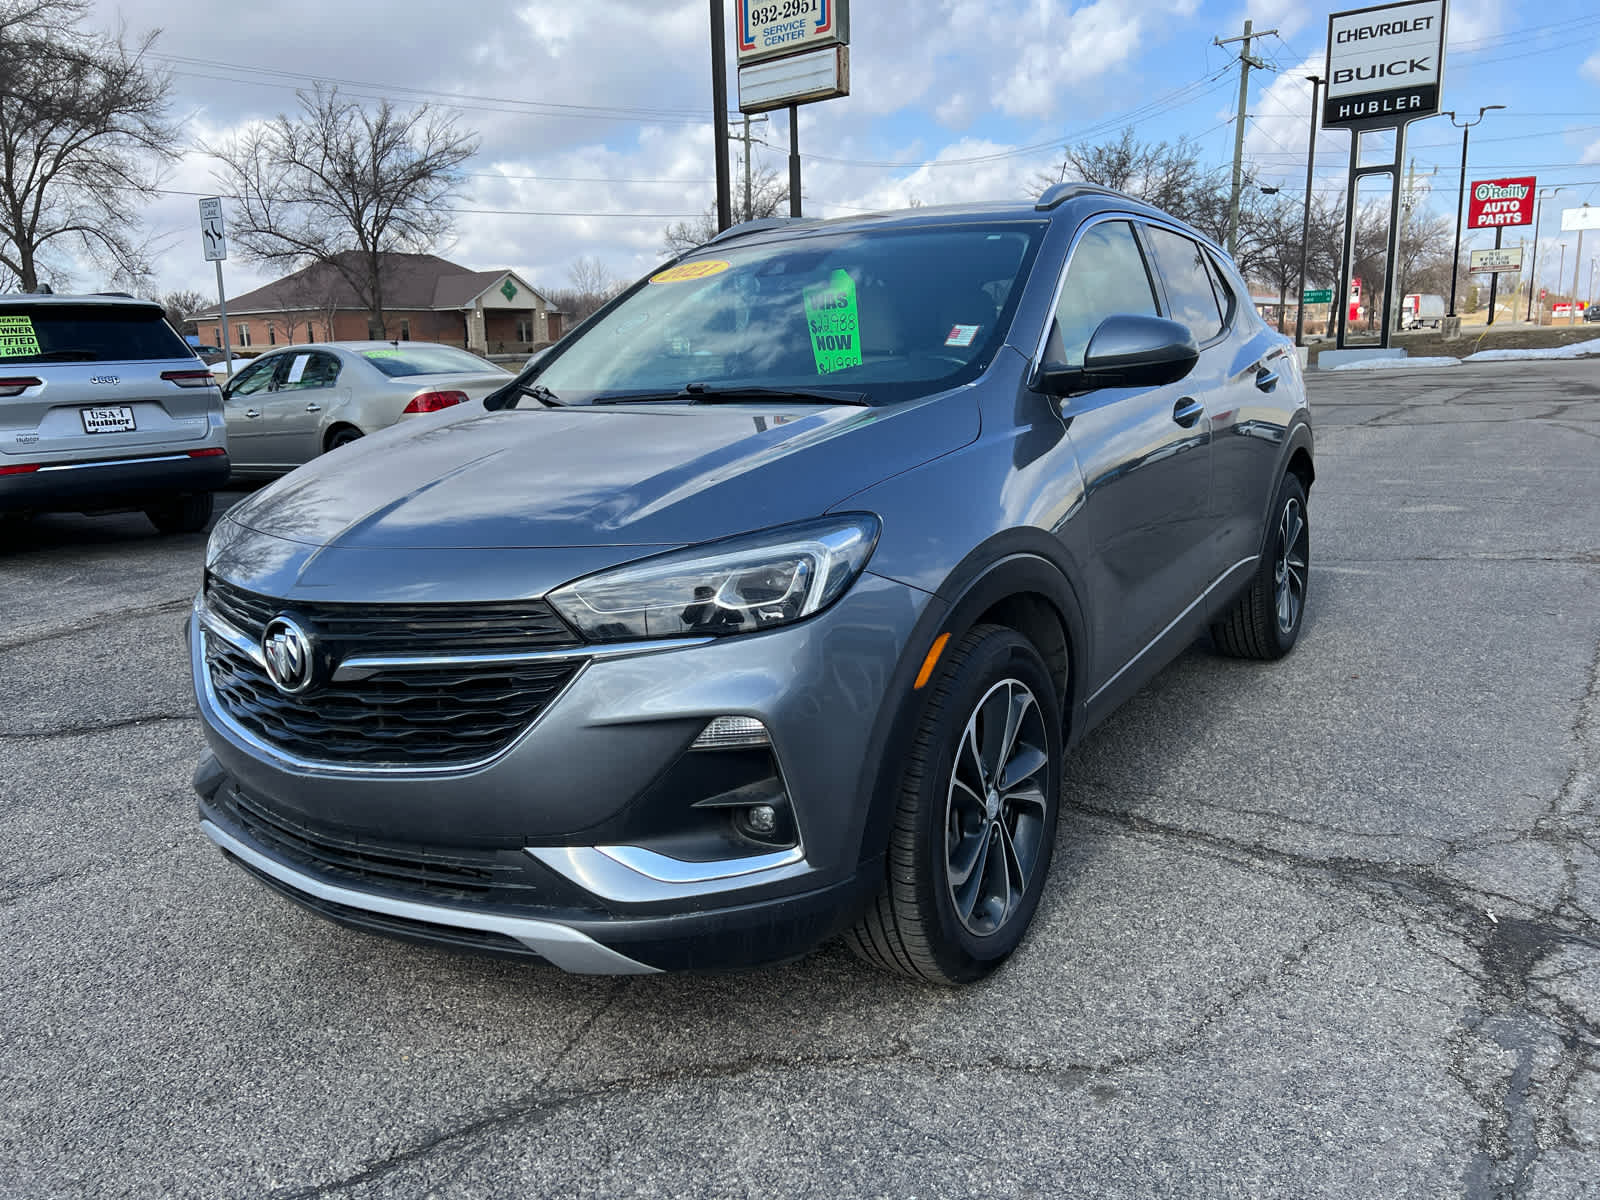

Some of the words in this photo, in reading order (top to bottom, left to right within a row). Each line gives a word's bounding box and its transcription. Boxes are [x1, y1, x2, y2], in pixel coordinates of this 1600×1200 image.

[752, 0, 817, 27] 932-2951
[762, 18, 806, 38] SERVICE
[1336, 16, 1434, 44] CHEVROLET
[763, 30, 805, 47] CENTER
[1333, 56, 1432, 85] BUICK
[1338, 95, 1421, 118] HUBLER
[1476, 184, 1529, 200] O'Reilly
[1482, 201, 1520, 213] AUTO
[1477, 212, 1522, 225] PARTS
[810, 291, 848, 311] WAS
[6, 346, 39, 355] CARFAX
[816, 334, 852, 351] NOW
[88, 418, 131, 427] Hubler
